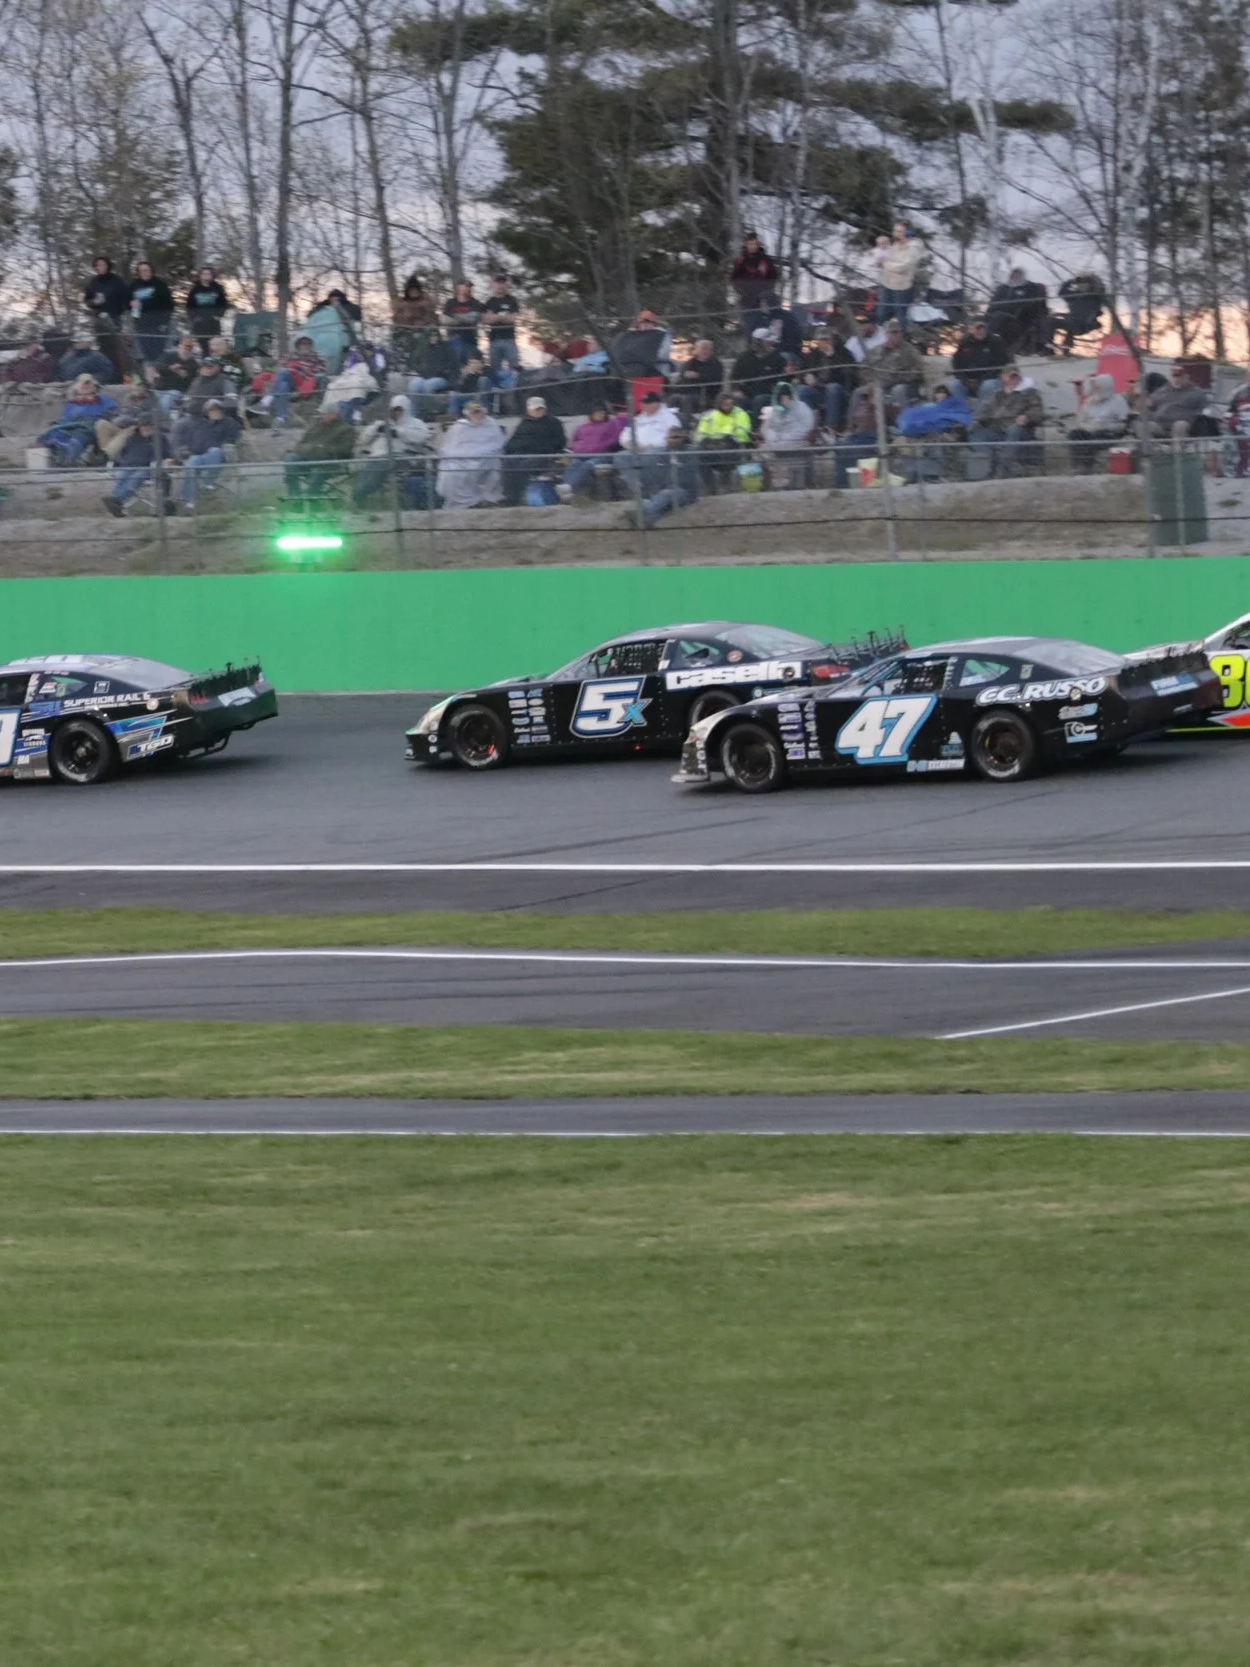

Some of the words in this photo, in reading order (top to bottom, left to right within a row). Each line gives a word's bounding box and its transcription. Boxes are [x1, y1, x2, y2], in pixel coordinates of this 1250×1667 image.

[64, 695, 115, 708] SUPERIOR
[117, 692, 141, 703] RAIL
[1024, 677, 1107, 700] RUSSO
[836, 696, 934, 761] 47
